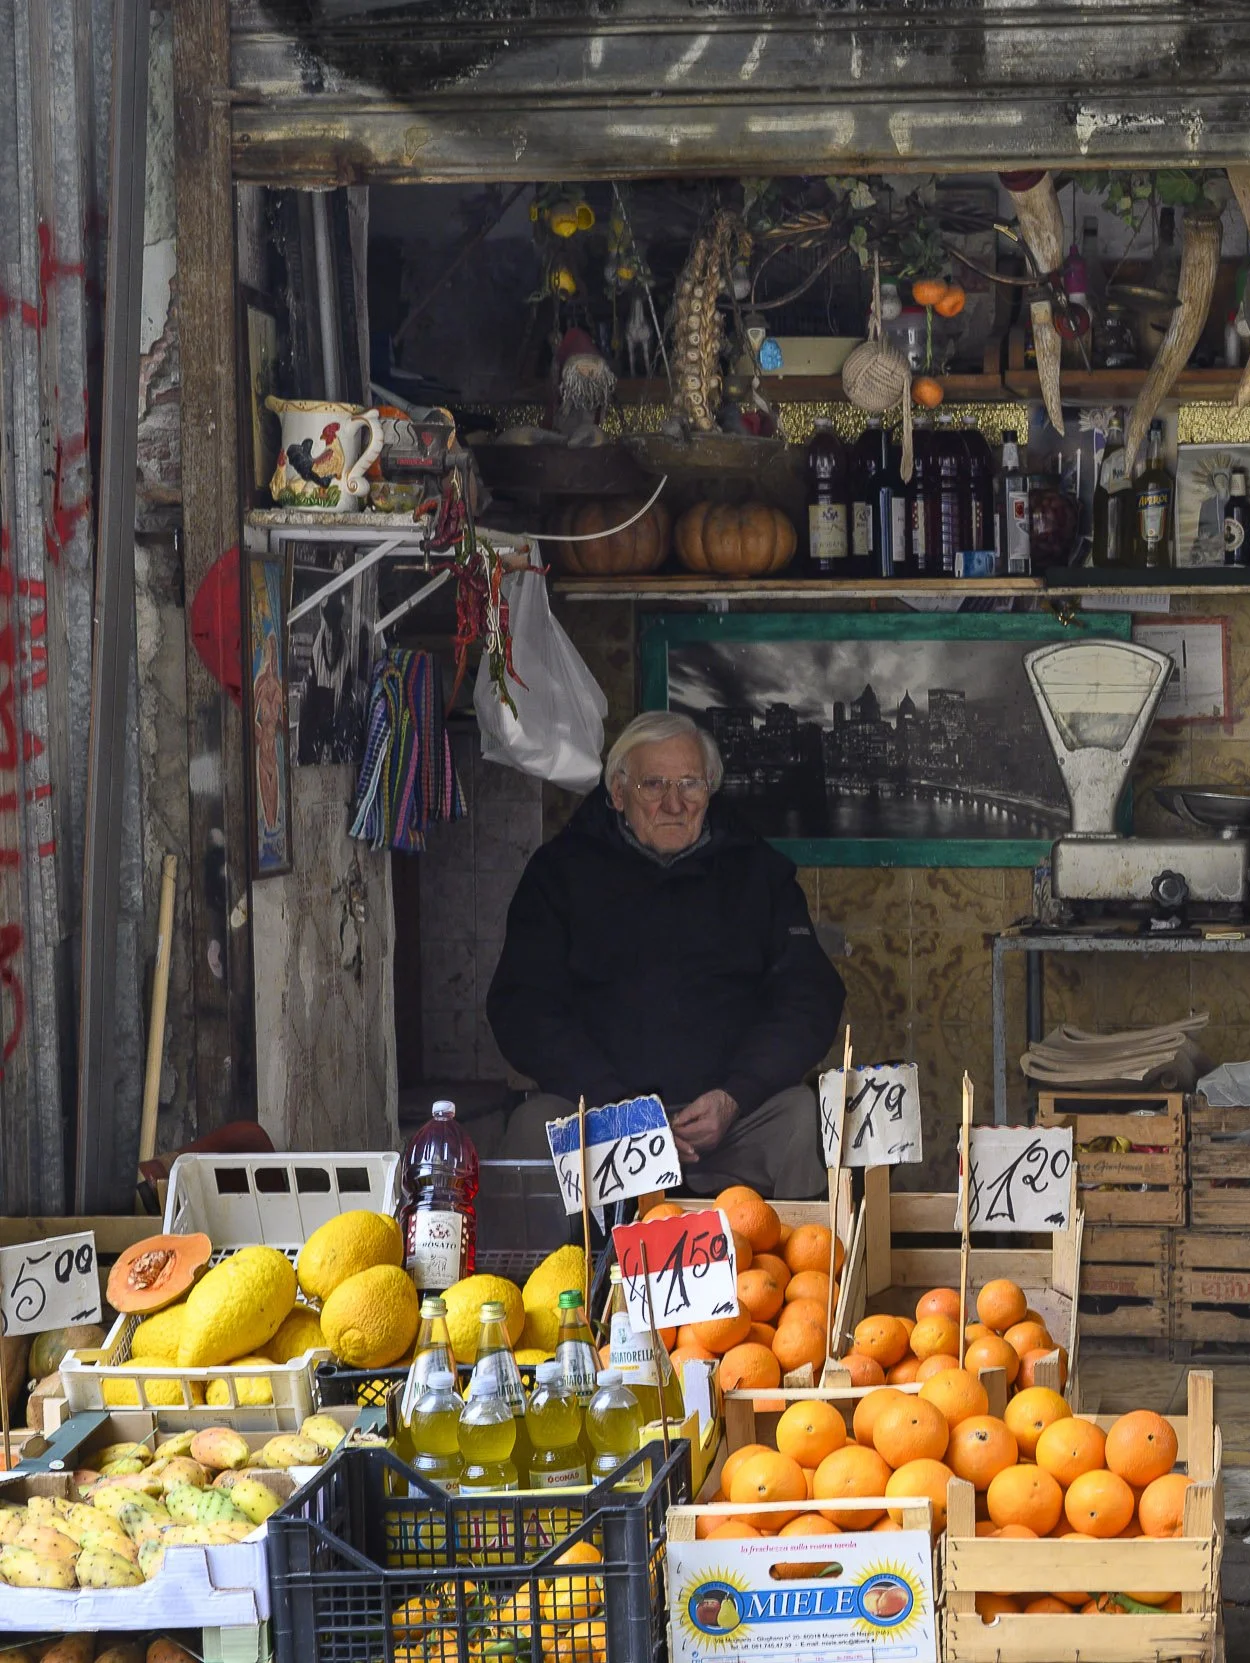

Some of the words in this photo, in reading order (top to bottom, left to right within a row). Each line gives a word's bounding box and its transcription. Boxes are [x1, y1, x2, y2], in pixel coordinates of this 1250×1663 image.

[422, 1241, 457, 1250] ROSATO
[740, 1545, 749, 1554] la
[749, 1543, 788, 1556] freschezza
[746, 1588, 855, 1620] MIELE
